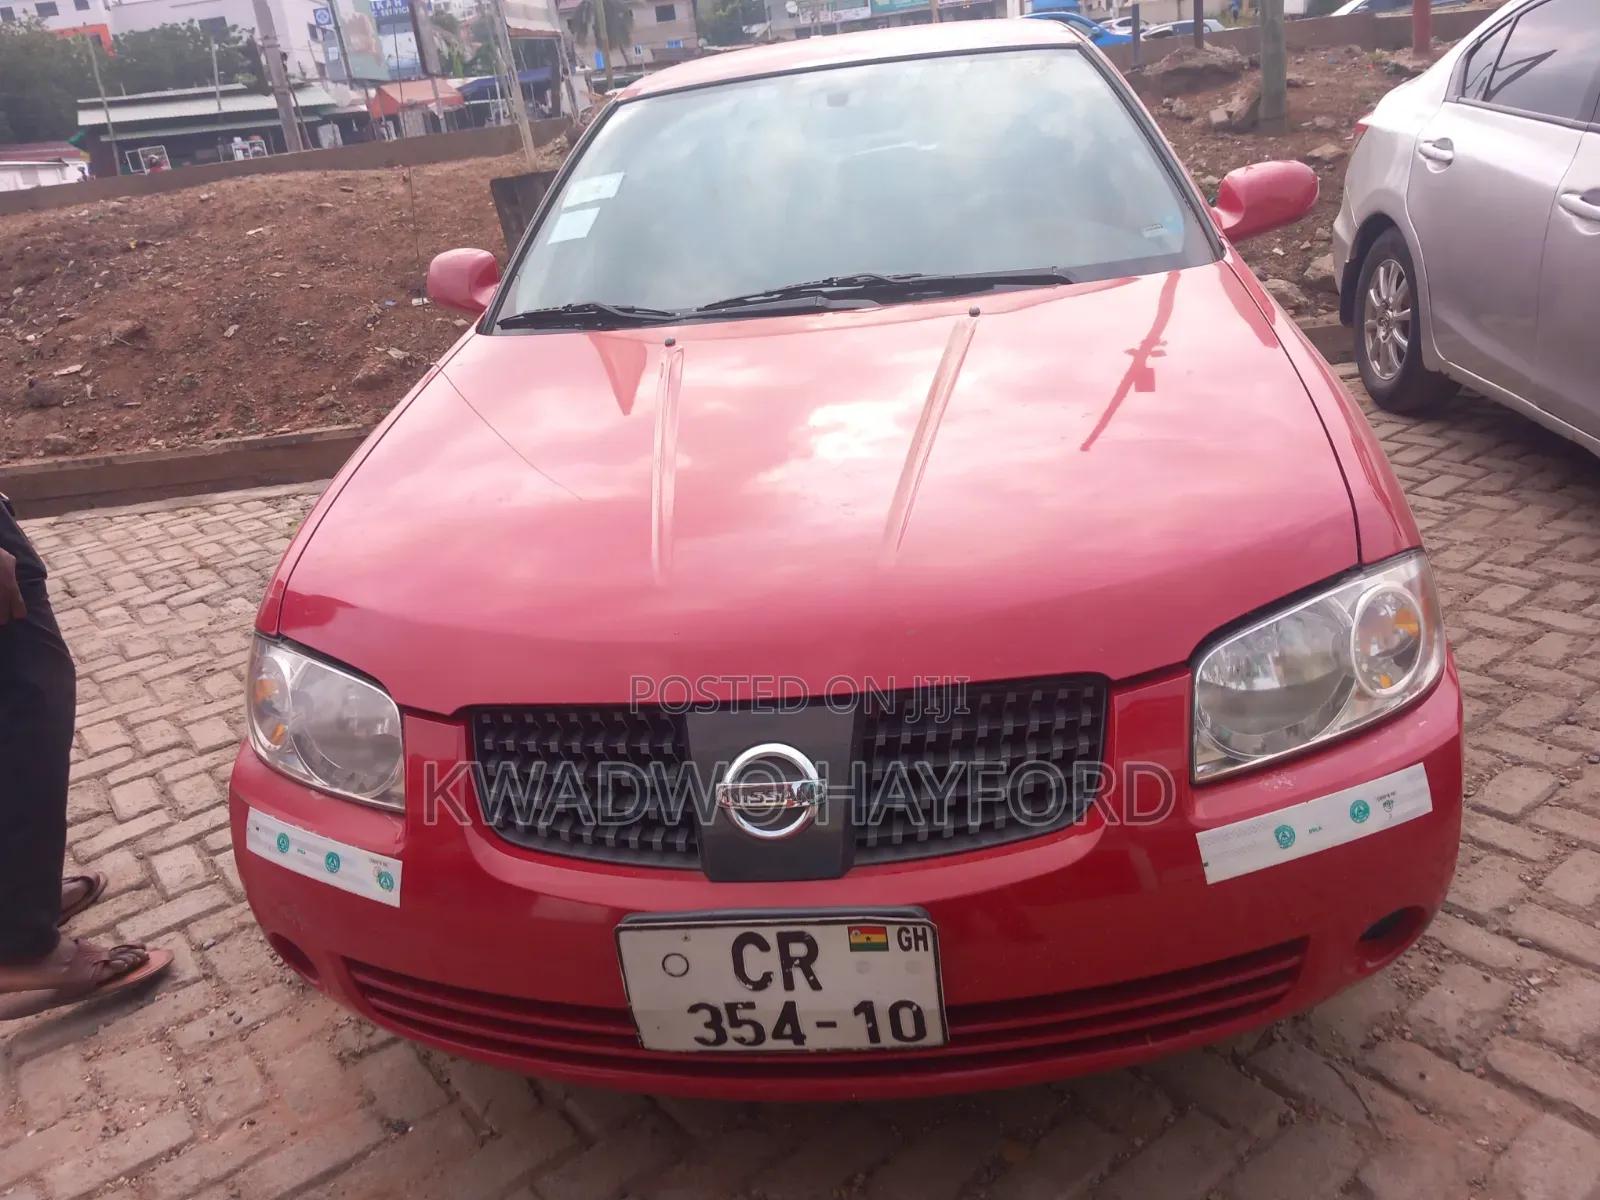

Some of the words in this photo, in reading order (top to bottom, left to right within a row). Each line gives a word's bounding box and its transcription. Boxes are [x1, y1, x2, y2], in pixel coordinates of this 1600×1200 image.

[731, 931, 823, 991] CR
[896, 926, 930, 952] GH
[686, 998, 928, 1046] 354-10
